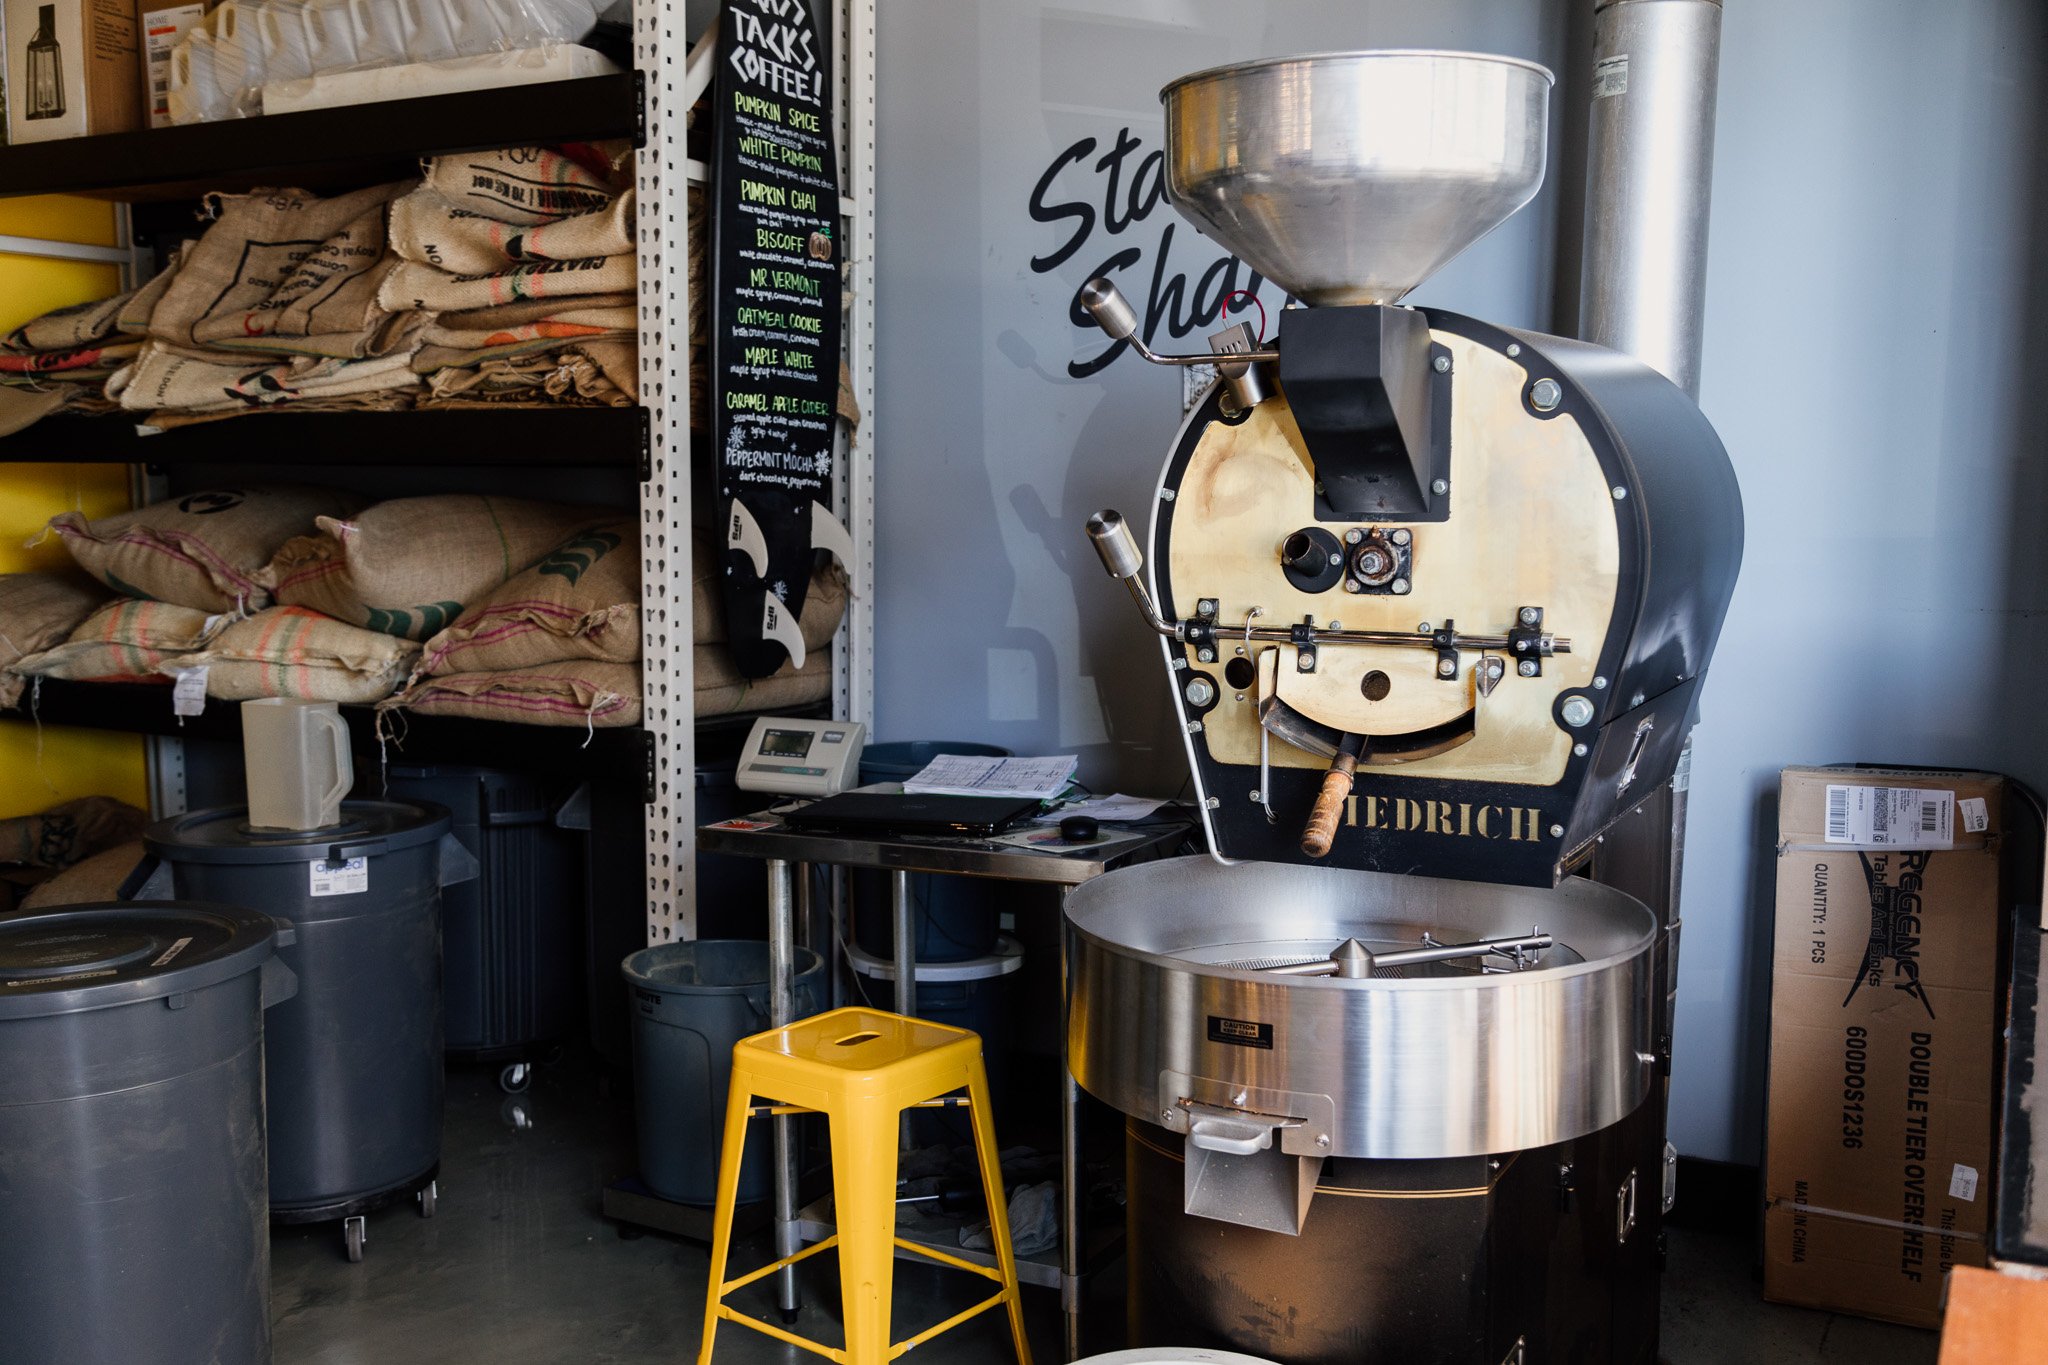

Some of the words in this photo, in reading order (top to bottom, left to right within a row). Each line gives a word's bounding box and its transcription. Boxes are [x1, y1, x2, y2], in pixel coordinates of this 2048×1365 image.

[729, 6, 816, 72] TACKS
[730, 45, 822, 107] COFFEE!
[735, 91, 781, 122] PUMPKIN
[788, 107, 820, 132] SPICE
[739, 136, 779, 160] WHITE
[781, 147, 822, 172] PUMPKIN
[741, 179, 785, 206] PUMPKIN
[790, 190, 816, 212] CHAI
[1029, 127, 1172, 273] Sta
[756, 228, 805, 253] BISCOFF
[771, 270, 821, 298] VERMONT
[738, 307, 787, 328] OATMEAL
[789, 313, 822, 333] COOKIE
[745, 346, 778, 367] MAPLE
[783, 350, 815, 369] WHITE
[726, 391, 769, 412] CARAMEL
[772, 396, 799, 413] APPLE
[801, 399, 829, 416] CIDER
[726, 447, 782, 468] PEPPERMINT
[783, 452, 814, 472] MOCHA
[1345, 794, 1542, 842] IEDRICH
[1813, 863, 1828, 924] QUANTITY:
[1872, 854, 1888, 905] Tables
[1871, 906, 1888, 939] And
[1811, 940, 1825, 964] PCS
[1869, 942, 1885, 987] Sinks
[1223, 1021, 1256, 1031] CAUTION
[1842, 1026, 1868, 1150] 600DOS1236
[1907, 1031, 1932, 1114] DOUBLE
[1905, 1114, 1928, 1162] TIER
[1794, 1214, 1807, 1227] IN
[1792, 1228, 1806, 1263] CHINA
